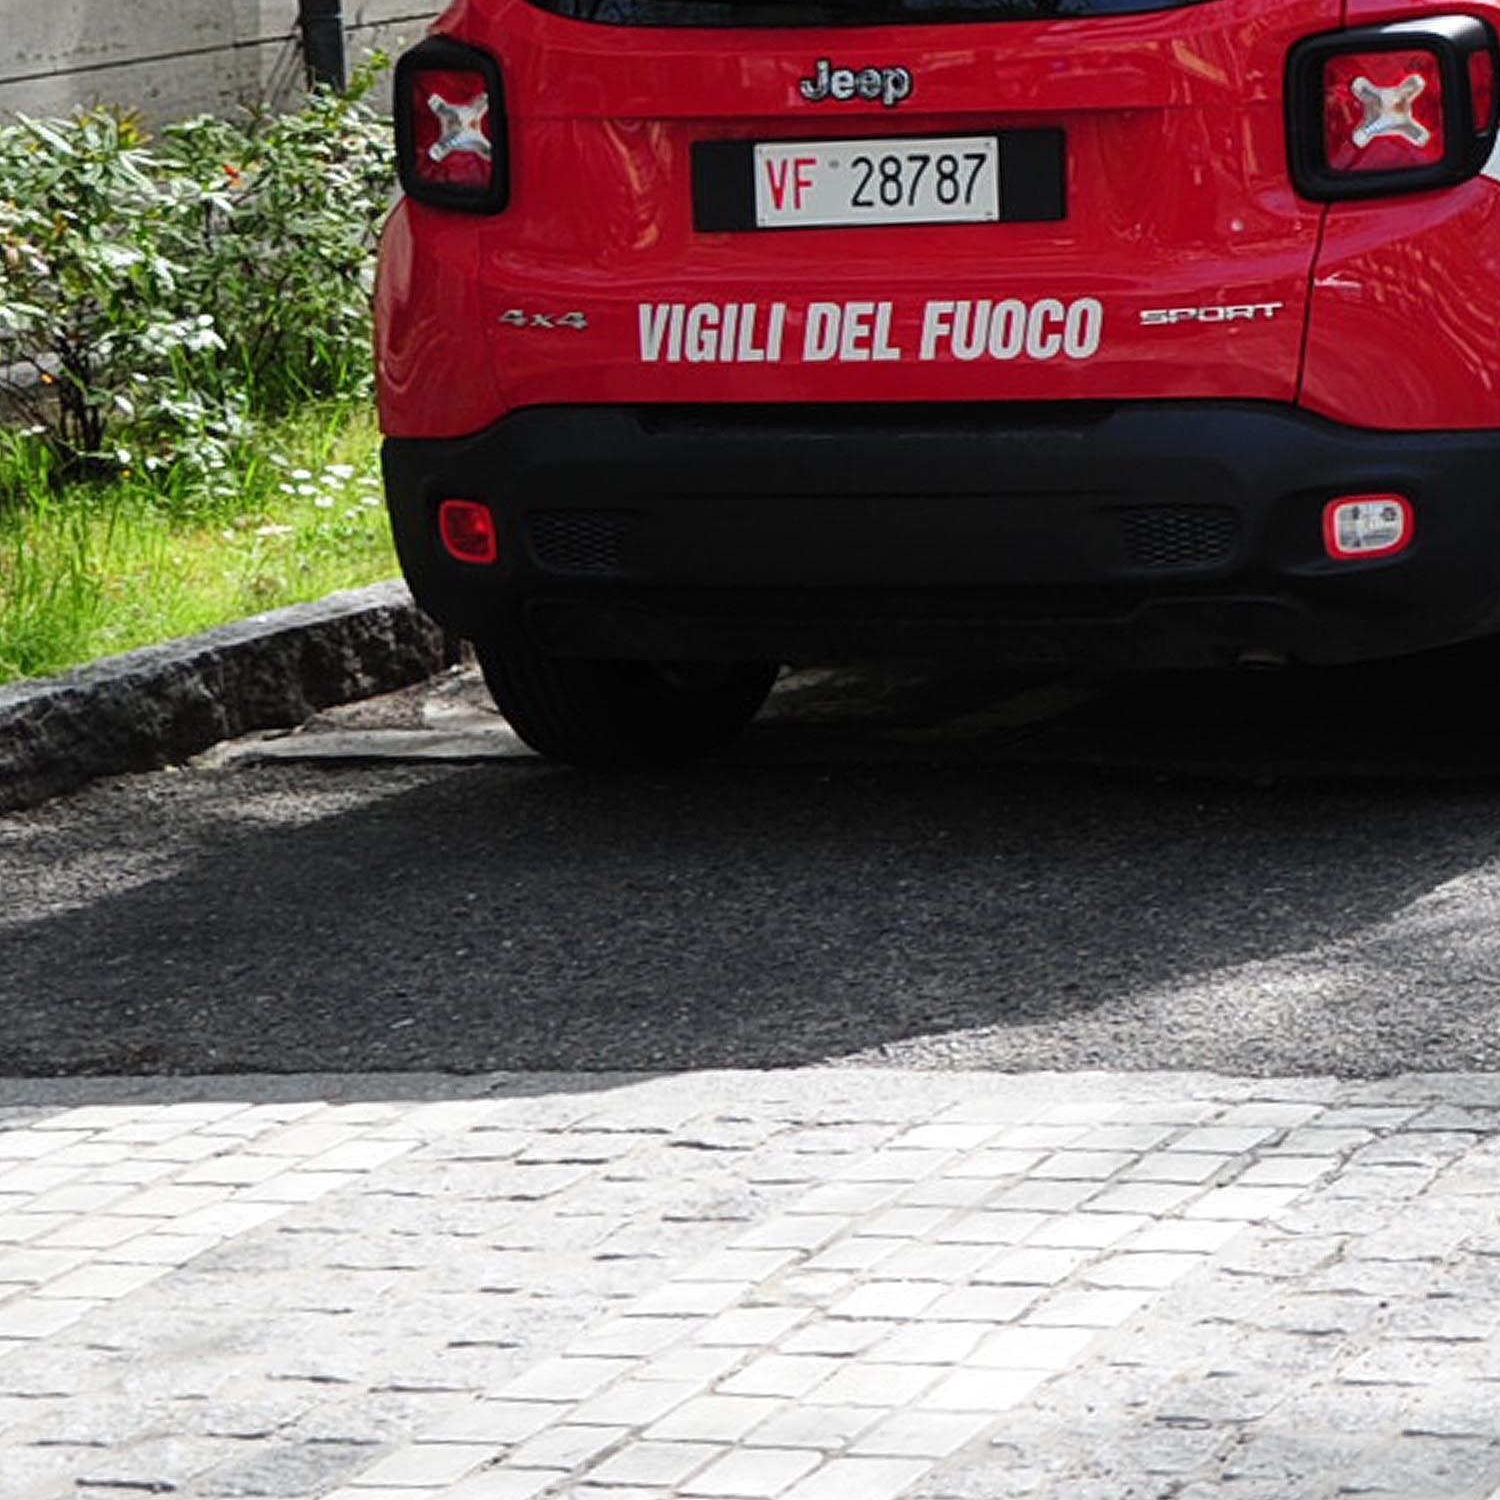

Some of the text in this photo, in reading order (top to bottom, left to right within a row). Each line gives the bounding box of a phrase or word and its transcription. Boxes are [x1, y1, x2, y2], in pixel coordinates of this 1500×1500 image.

[800, 60, 911, 107] Jeep
[765, 152, 988, 211] VF 28787
[500, 308, 589, 330] 4x4
[638, 297, 1104, 363] VIGILI DEL FUOCO
[1139, 301, 1284, 326] SPORT
